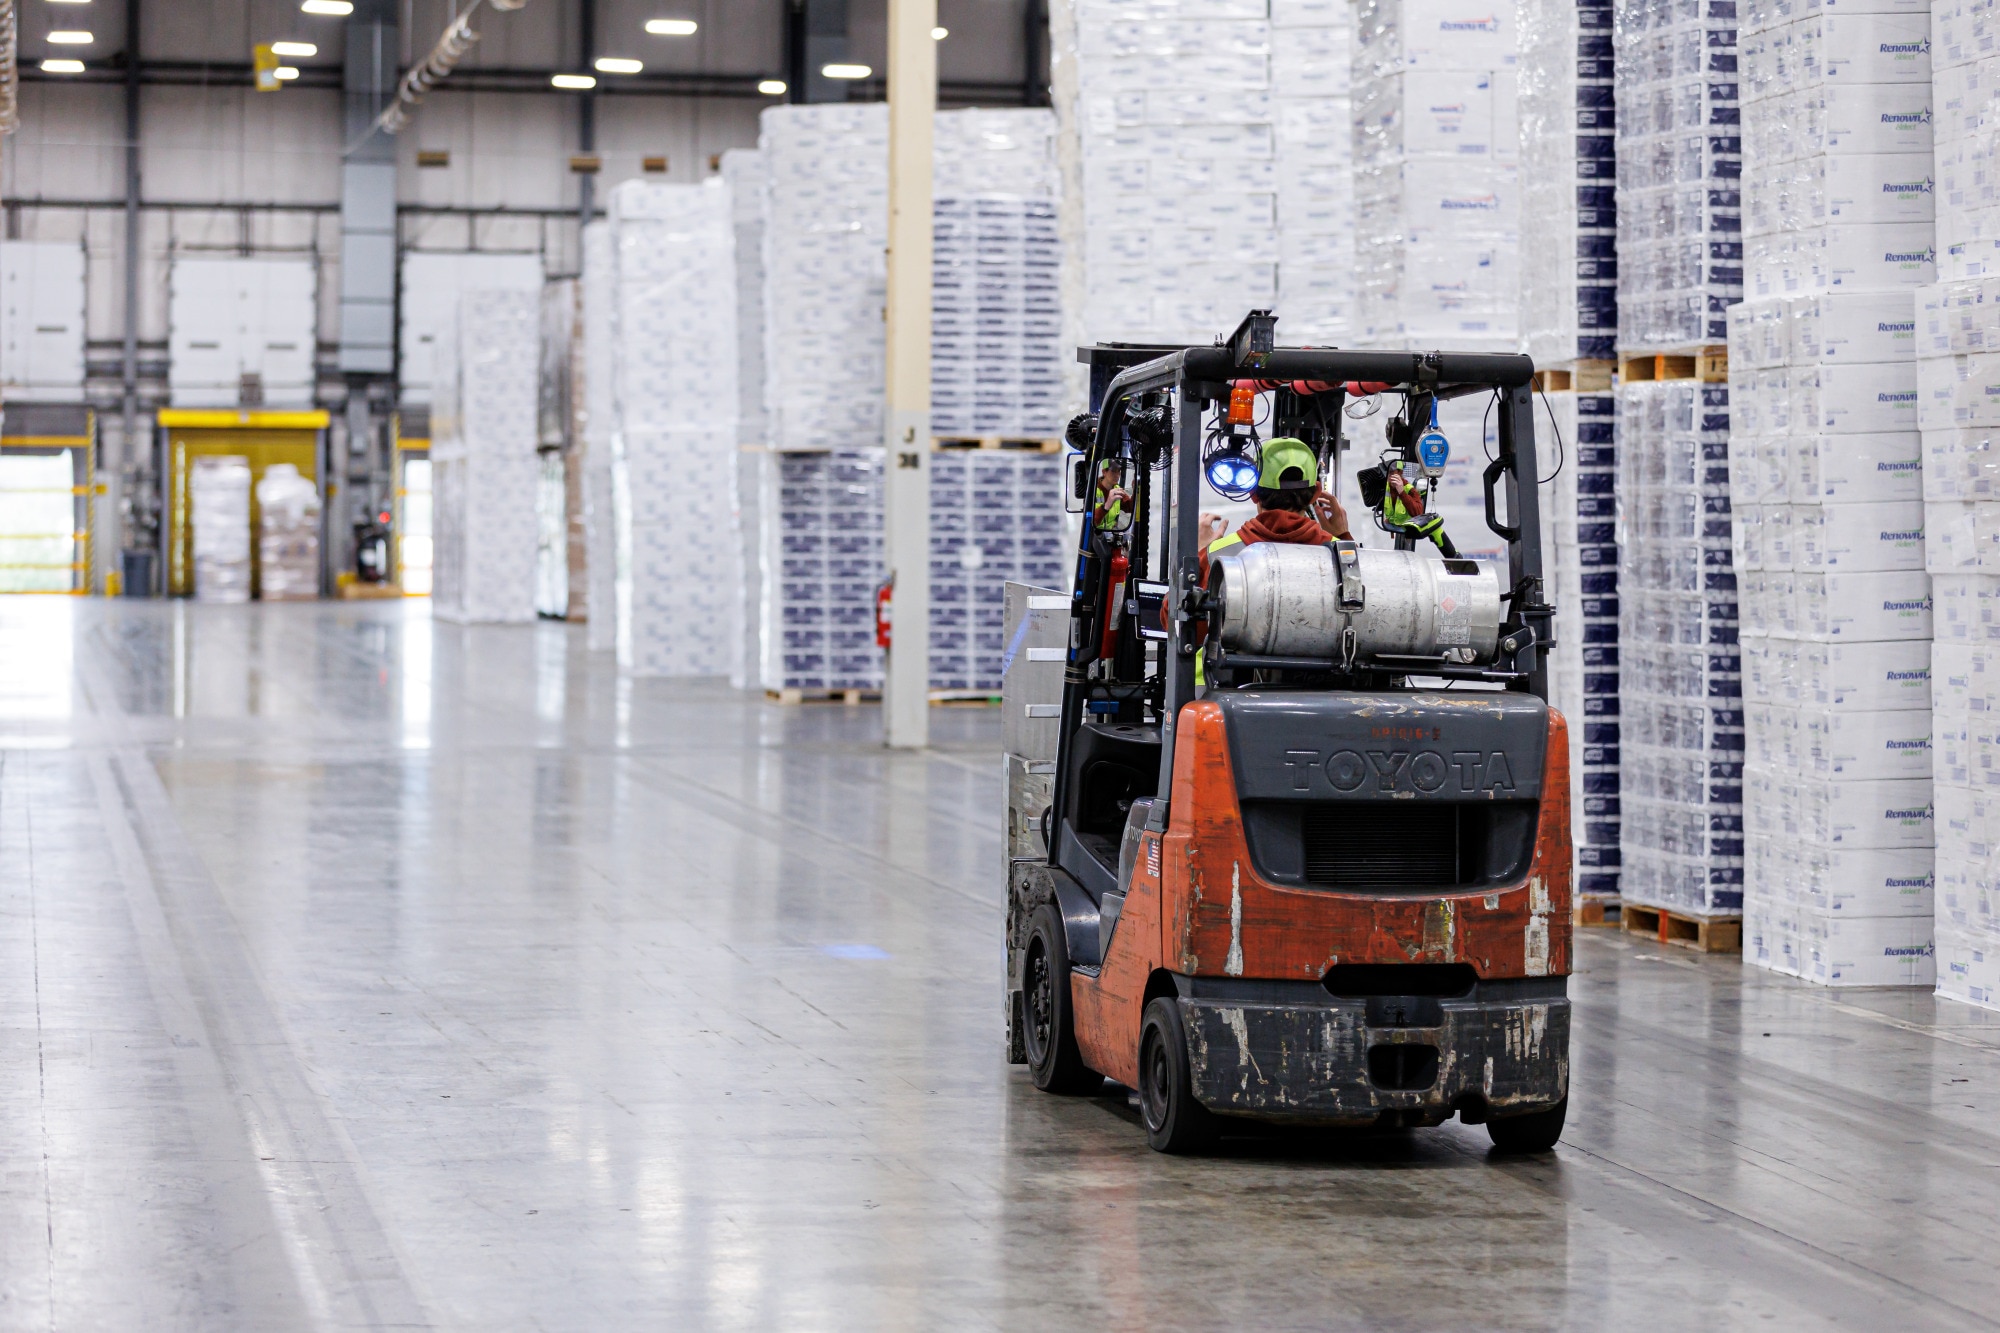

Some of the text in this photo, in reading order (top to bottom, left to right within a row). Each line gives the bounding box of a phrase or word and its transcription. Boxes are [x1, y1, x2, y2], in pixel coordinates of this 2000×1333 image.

[1880, 43, 1920, 53] Renown
[1881, 113, 1921, 123] Renown
[1883, 183, 1923, 193] Renown
[1885, 252, 1925, 262] Renown
[1878, 392, 1918, 402] Renown
[1878, 462, 1918, 472] Renown
[1880, 531, 1920, 541] Renown
[1883, 601, 1924, 610] Renown
[1886, 671, 1927, 680] Renown
[1886, 740, 1926, 750] Renown
[1285, 749, 1516, 793] TOYOTA
[1885, 809, 1926, 819] Renown
[1885, 878, 1925, 887] Renown
[1884, 948, 1924, 956] Renown
